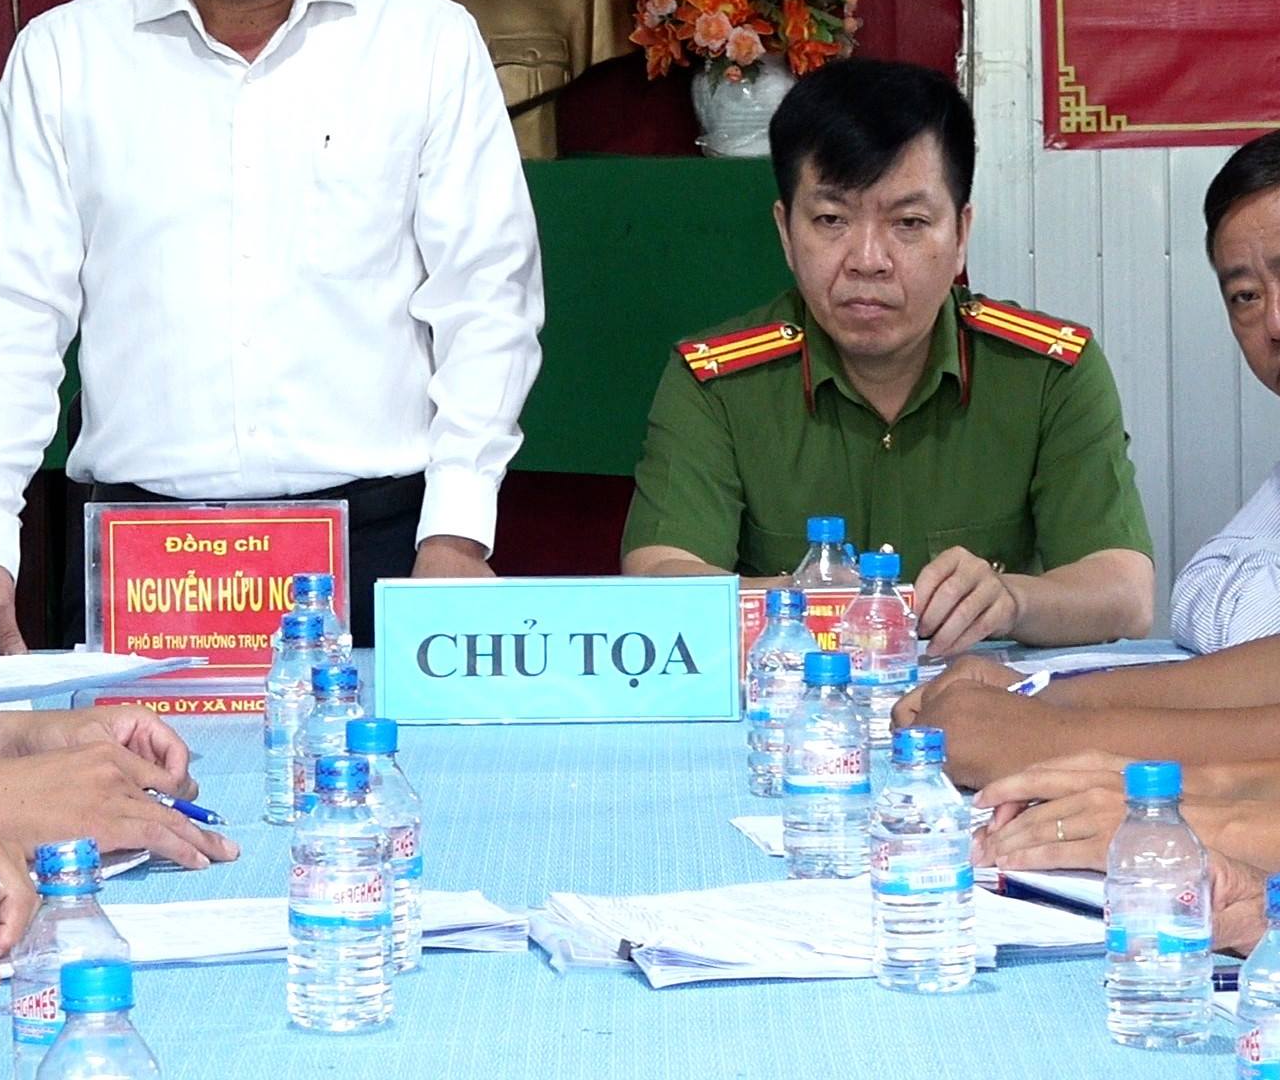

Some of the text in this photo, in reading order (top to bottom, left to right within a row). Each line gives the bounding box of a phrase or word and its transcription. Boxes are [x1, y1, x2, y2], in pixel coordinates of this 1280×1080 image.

[164, 533, 270, 556] Đồng chí
[126, 570, 213, 613] NGUYỄN
[218, 570, 263, 612] HỮU
[127, 632, 269, 652] PHÓ BÍ THƯ THƯỜNG TRỰC
[416, 619, 702, 688] CHỦ TỌA
[203, 698, 227, 713] XÃ
